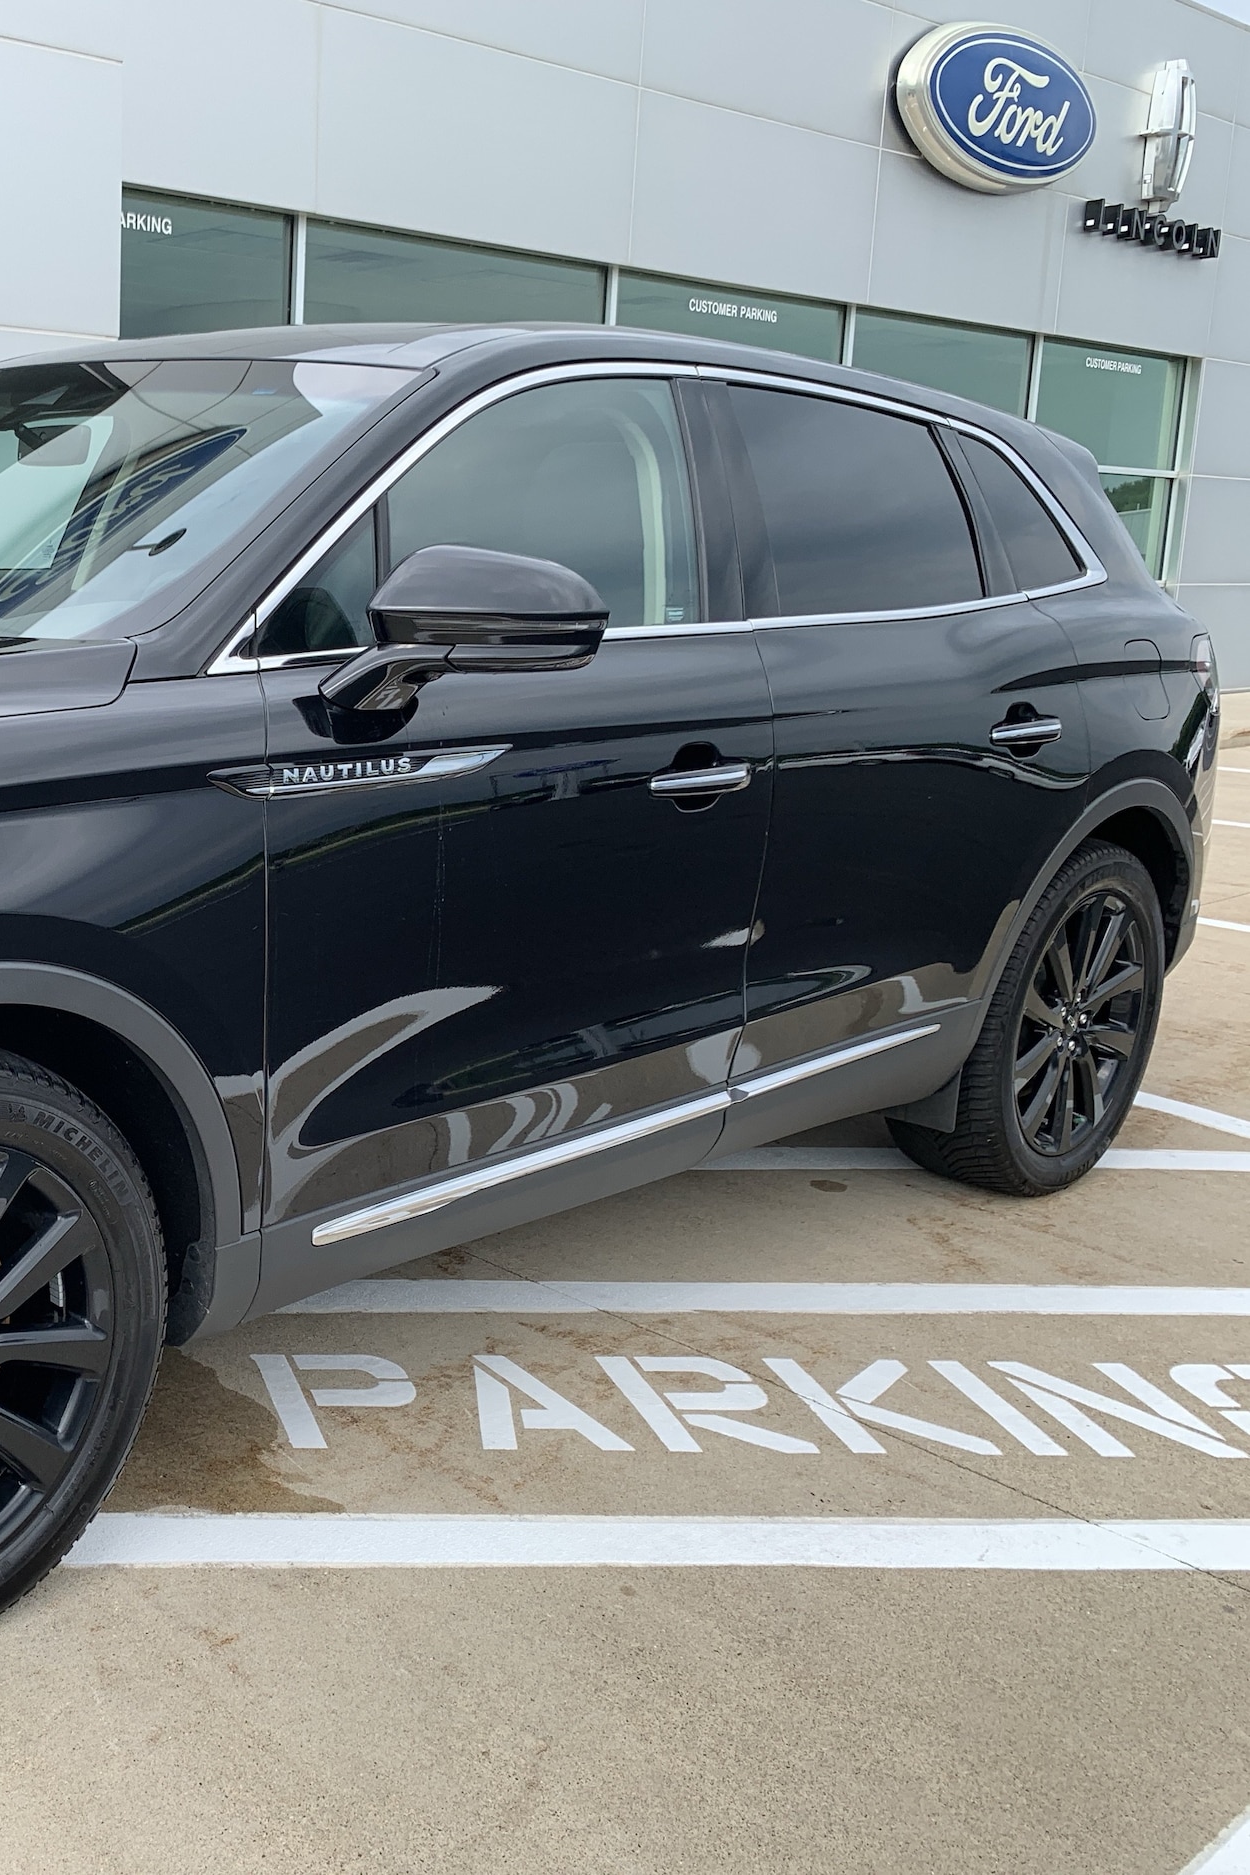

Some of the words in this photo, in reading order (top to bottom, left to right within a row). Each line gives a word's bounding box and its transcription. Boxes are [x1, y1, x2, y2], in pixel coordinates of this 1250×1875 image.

[967, 57, 1071, 157] Ford
[689, 298, 738, 318] CUSTOMER
[740, 306, 778, 323] PARKING
[1086, 357, 1117, 370] CUSTOMER
[1118, 362, 1142, 374] PARKING
[283, 757, 412, 785] NAUTILUS
[33, 1110, 129, 1200] MICHELIN
